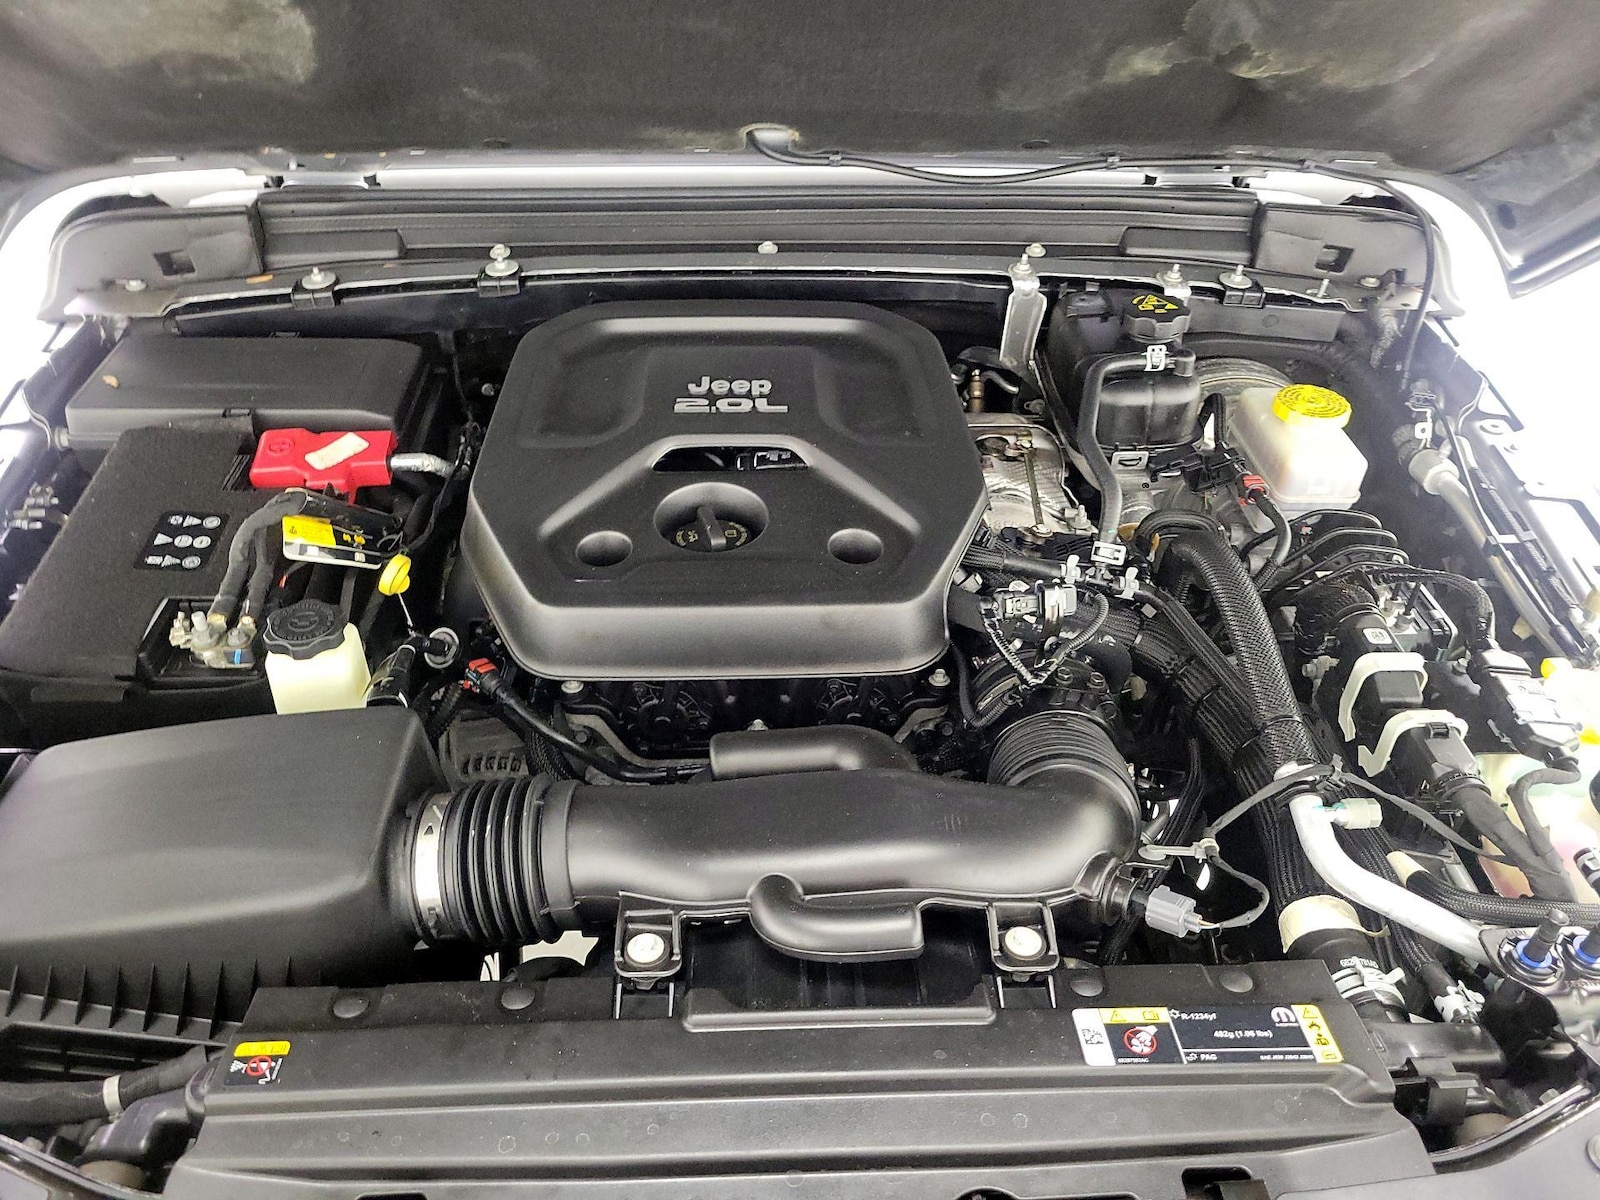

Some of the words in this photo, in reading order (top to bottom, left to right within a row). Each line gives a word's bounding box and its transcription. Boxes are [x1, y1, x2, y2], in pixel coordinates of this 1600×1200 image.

[687, 376, 772, 397] Jeep
[674, 398, 788, 413] 2.0L
[1257, 1029, 1274, 1039] lbs)
